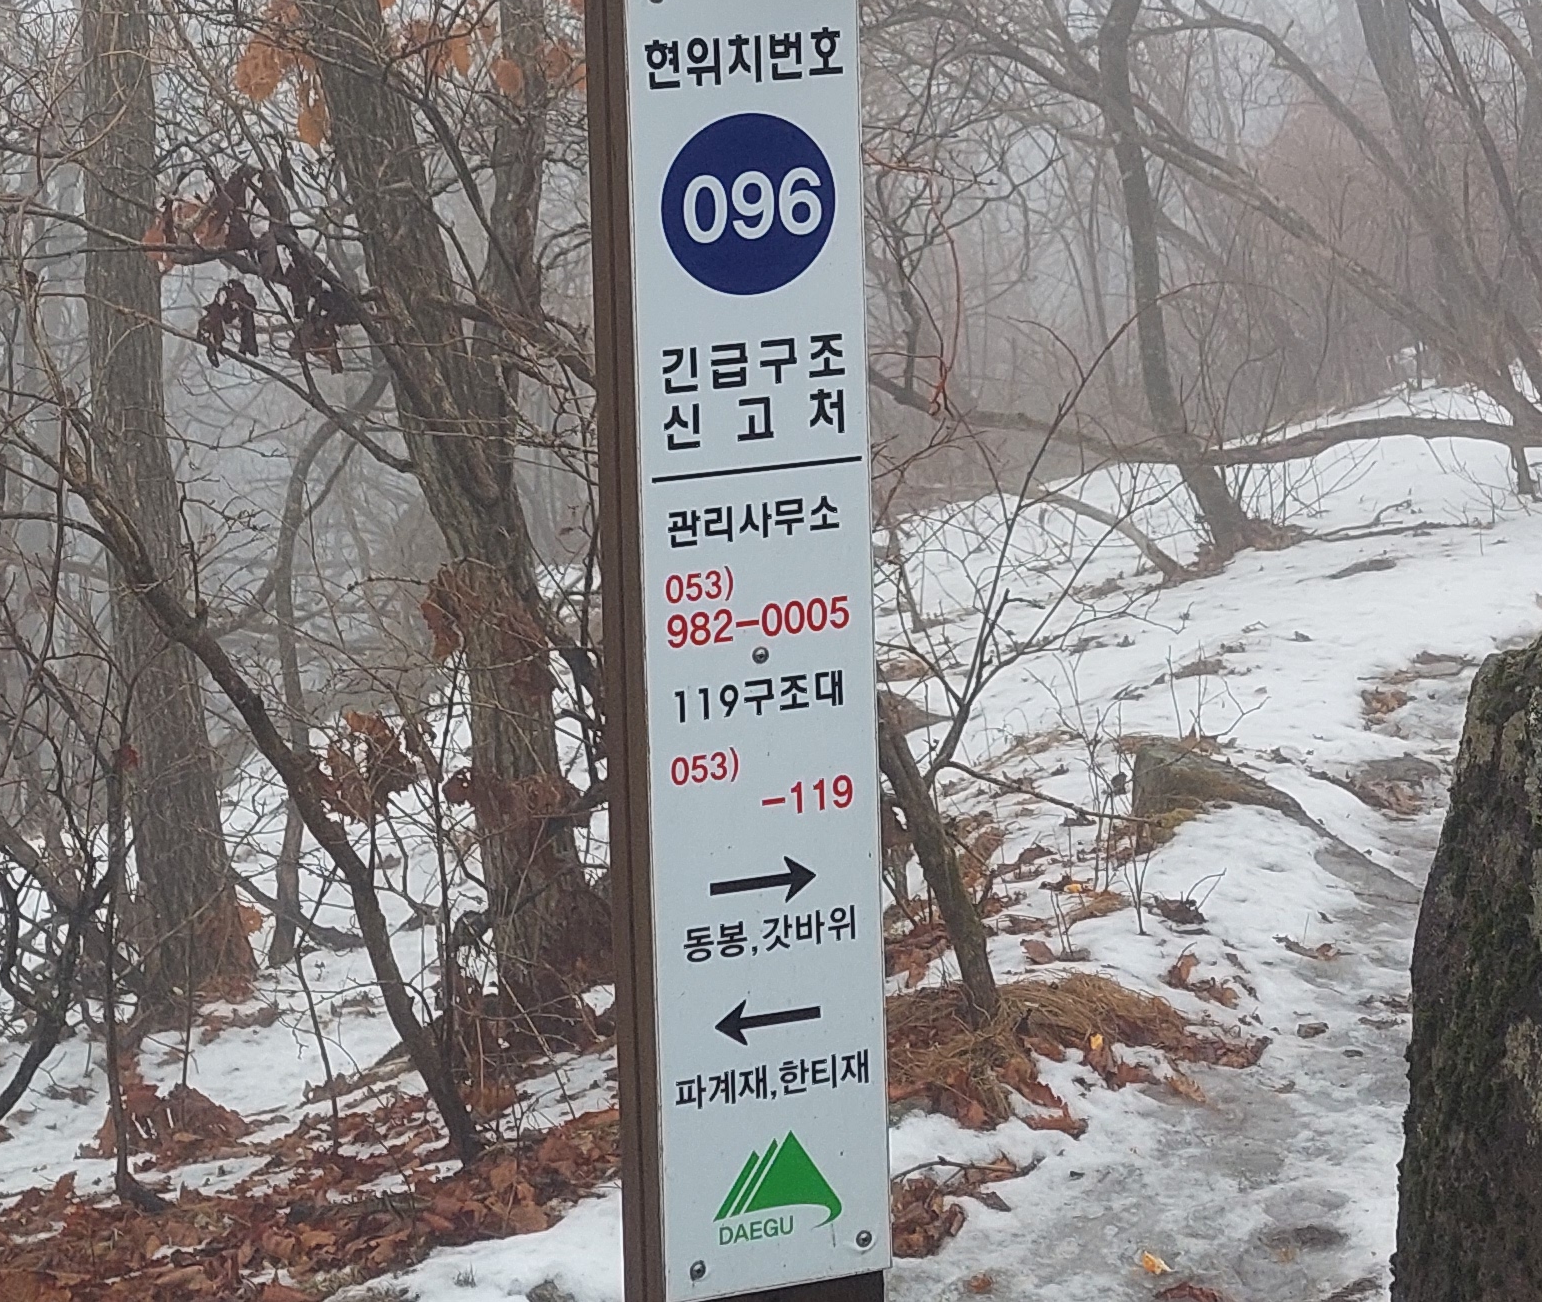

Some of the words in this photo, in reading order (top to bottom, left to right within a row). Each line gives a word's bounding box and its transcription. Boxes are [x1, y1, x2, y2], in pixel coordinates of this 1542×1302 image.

[643, 26, 844, 90] 현위치번호
[683, 166, 822, 244] 096
[662, 333, 846, 394] 긴급구조
[667, 495, 841, 549] 관리사무소
[665, 565, 734, 603] 053)
[666, 595, 850, 648] 982-0005
[674, 669, 844, 723] 119구조대
[671, 747, 740, 786] 053)
[761, 774, 854, 814] -119
[719, 1216, 794, 1246] DAEGU
